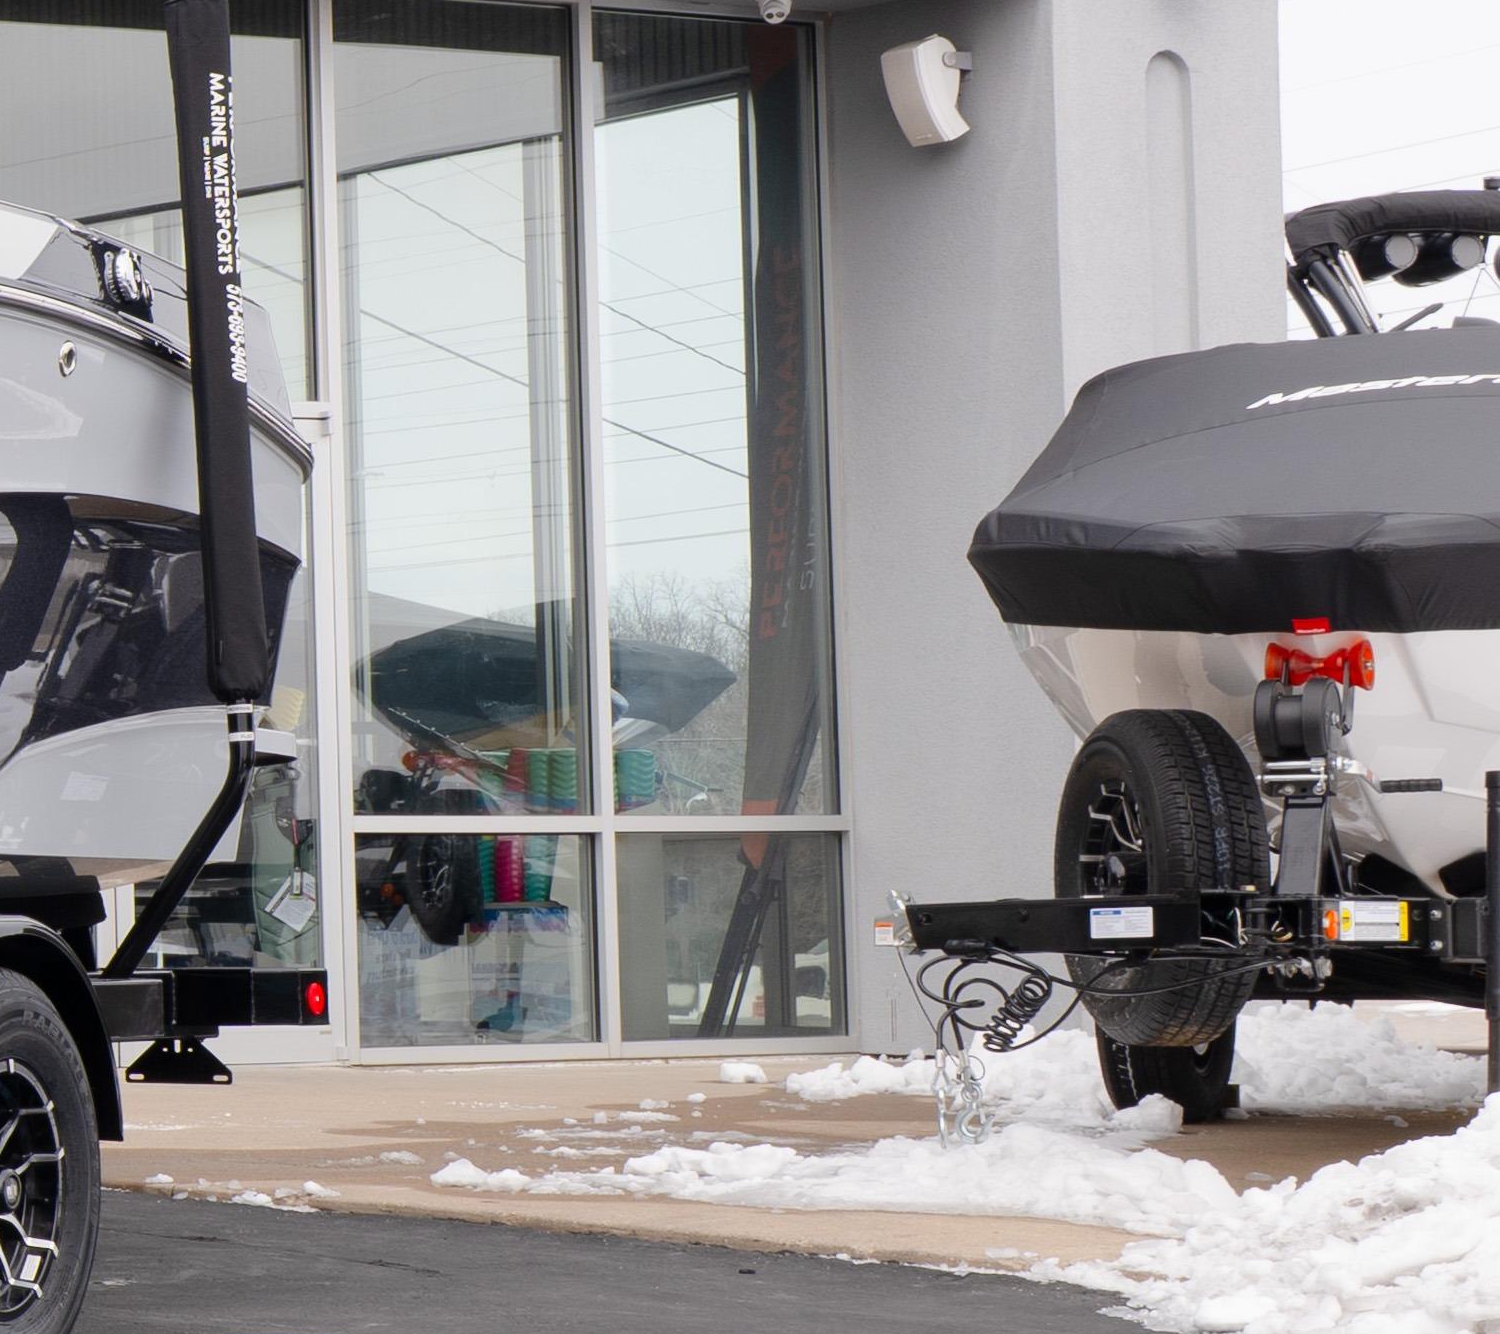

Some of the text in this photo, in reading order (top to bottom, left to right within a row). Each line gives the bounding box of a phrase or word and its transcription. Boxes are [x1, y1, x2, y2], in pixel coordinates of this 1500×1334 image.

[209, 72, 234, 275] MARINE WATERSPORTS
[1246, 374, 1500, 410] Master
